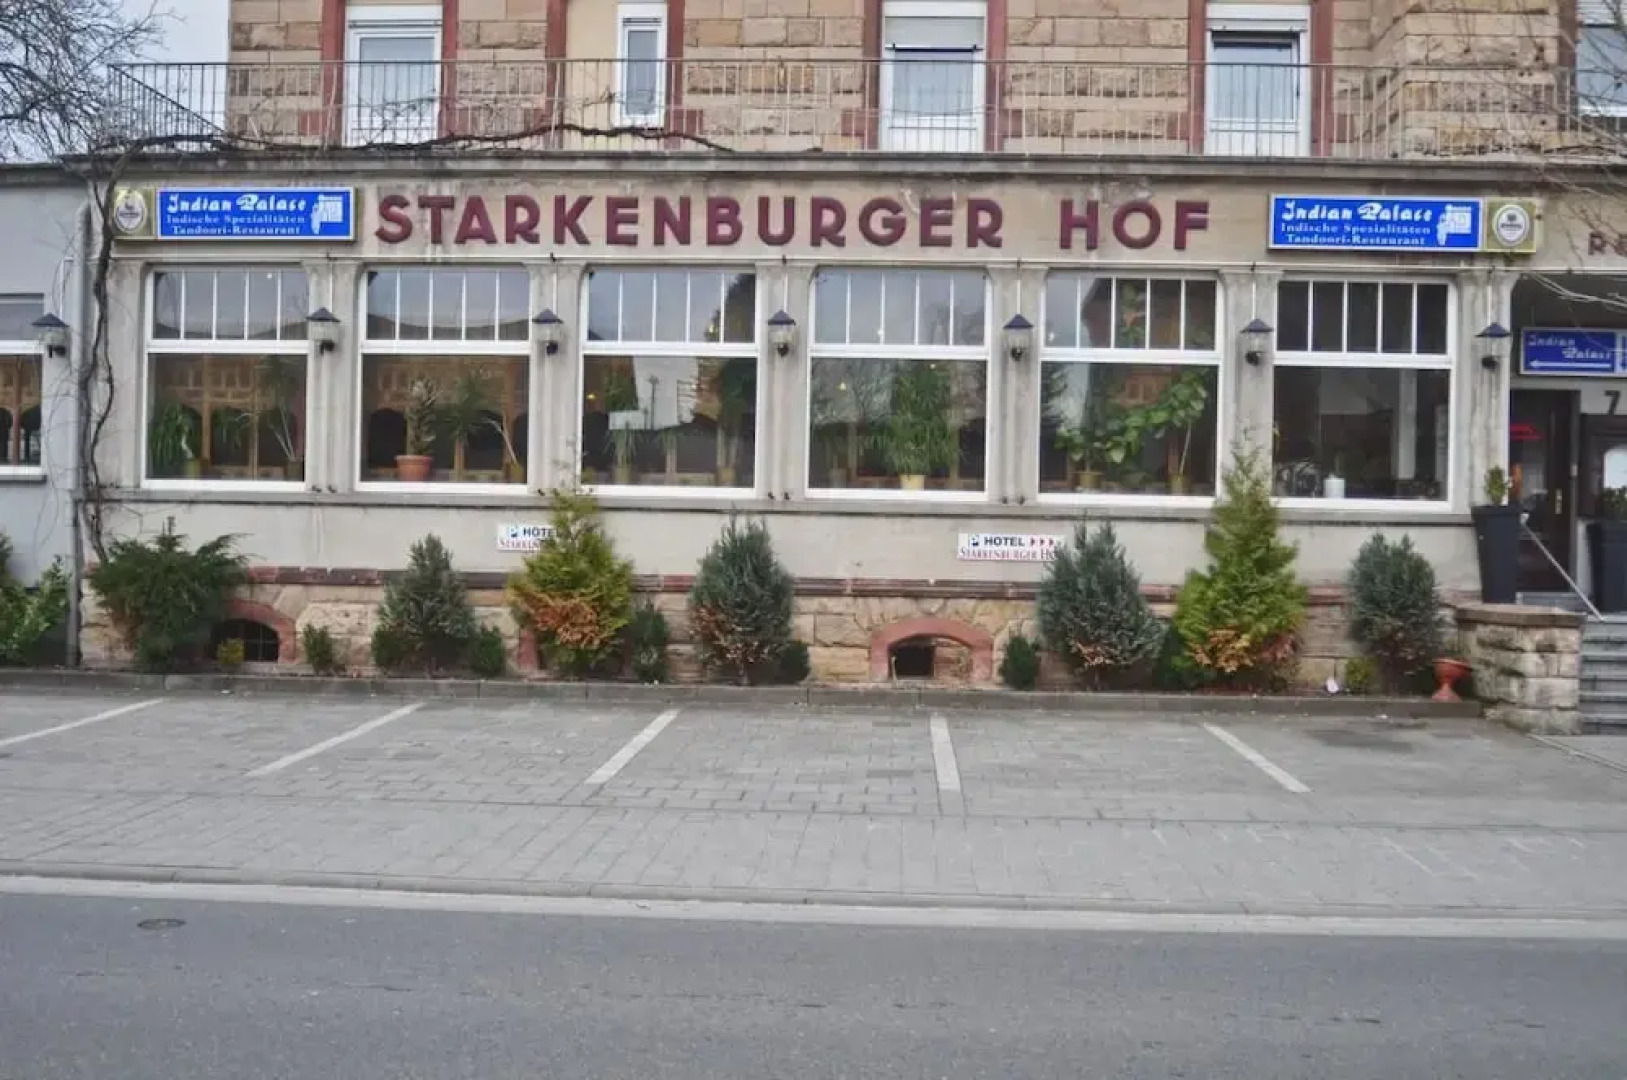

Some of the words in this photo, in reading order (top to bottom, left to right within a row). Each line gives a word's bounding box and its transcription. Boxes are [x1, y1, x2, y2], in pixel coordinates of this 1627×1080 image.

[167, 193, 232, 212] Indian
[1281, 200, 1353, 220] Indian
[374, 193, 1003, 248] STARKENBURGER
[1060, 198, 1210, 250] HOF
[1281, 222, 1338, 233] Indische
[1604, 389, 1620, 414] 7
[523, 526, 556, 538] HOTE
[984, 536, 1025, 547] HOTEL
